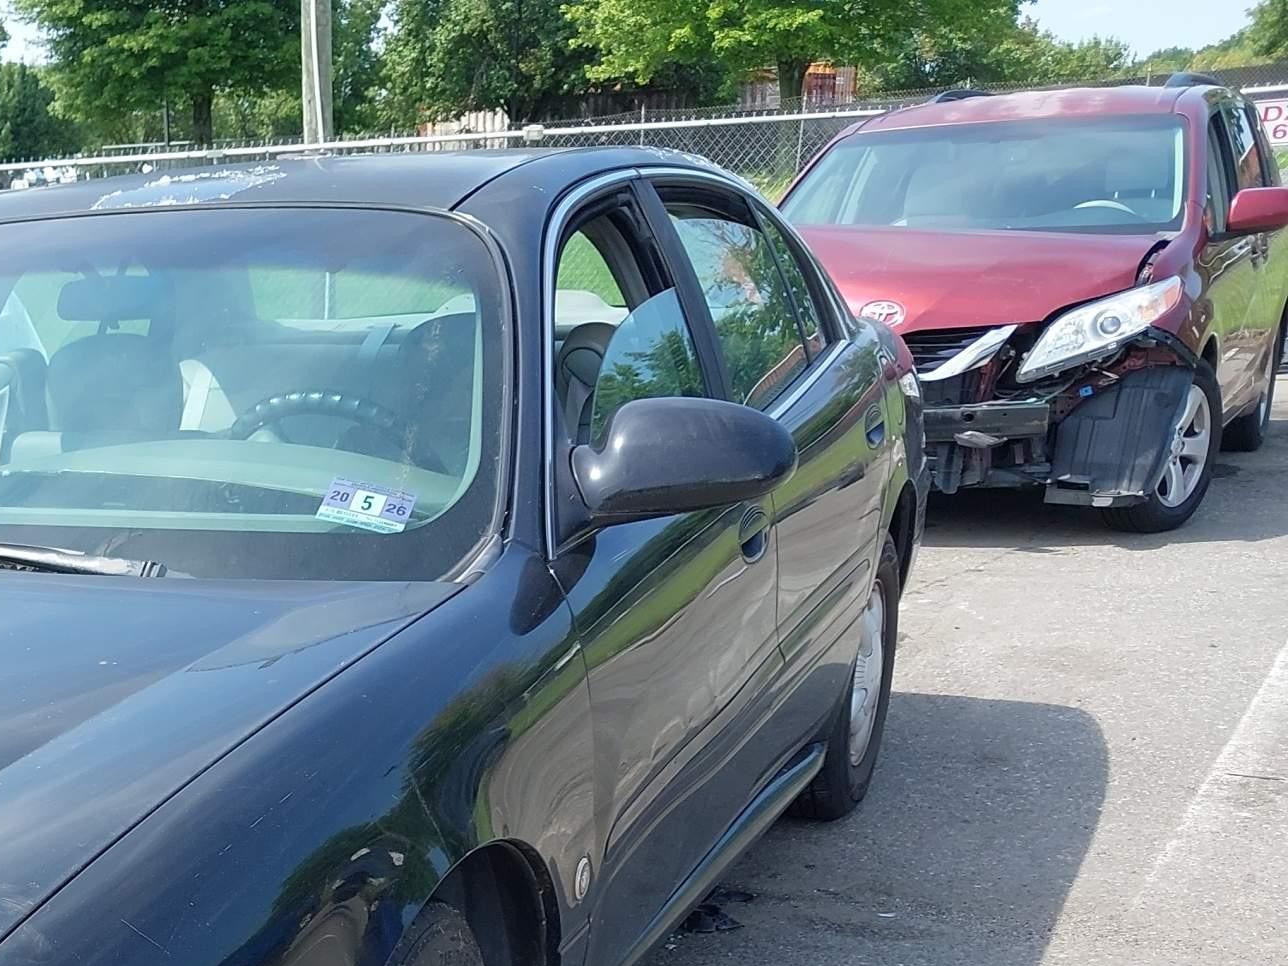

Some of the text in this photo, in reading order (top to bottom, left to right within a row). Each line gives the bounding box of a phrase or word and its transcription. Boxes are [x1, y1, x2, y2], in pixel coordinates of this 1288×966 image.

[1272, 123, 1288, 140] 6
[329, 490, 350, 503] 20
[360, 495, 375, 511] 5
[385, 503, 408, 517] 26
